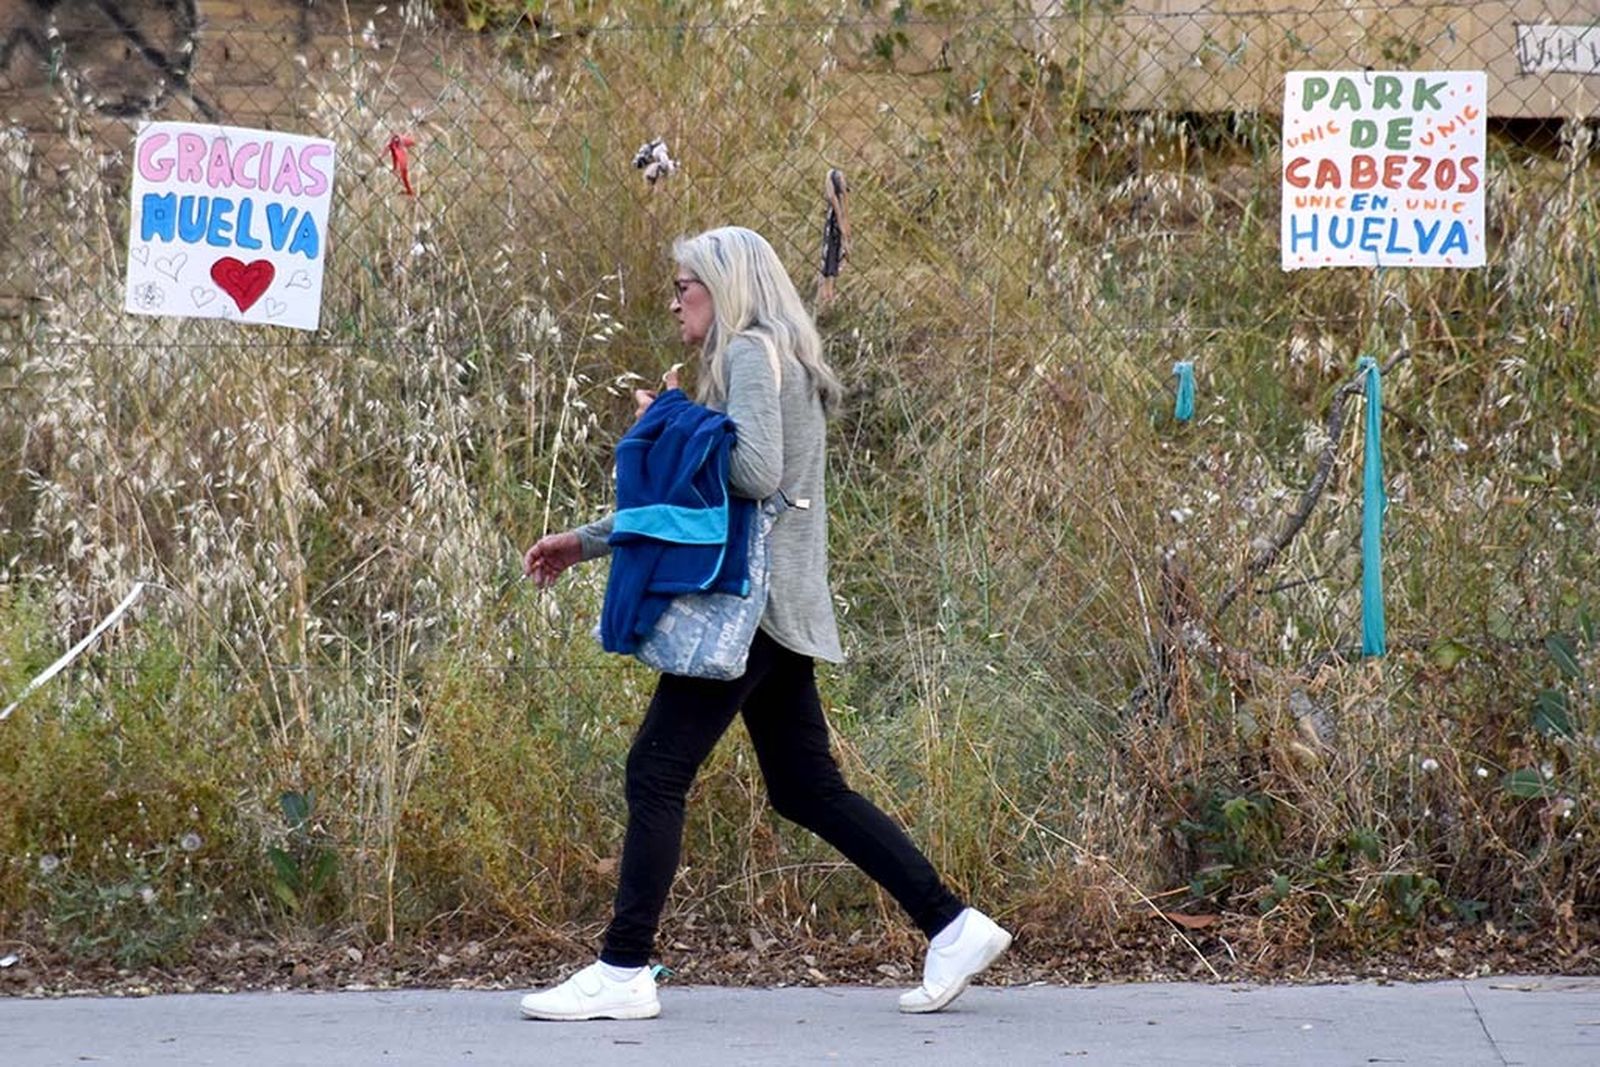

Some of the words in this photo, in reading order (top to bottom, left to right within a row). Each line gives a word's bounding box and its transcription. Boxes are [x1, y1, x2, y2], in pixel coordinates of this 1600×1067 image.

[1302, 76, 1448, 111] PARK
[1287, 120, 1340, 148] UNIC
[1350, 117, 1413, 150] DE
[1420, 105, 1479, 146] UNIC
[138, 133, 331, 197] GRACIAS
[1285, 155, 1479, 193] CABEZOS
[1295, 195, 1346, 209] UNIC
[1351, 193, 1388, 212] EN
[1406, 199, 1466, 213] UNIC
[1291, 213, 1469, 255] HUELVA
